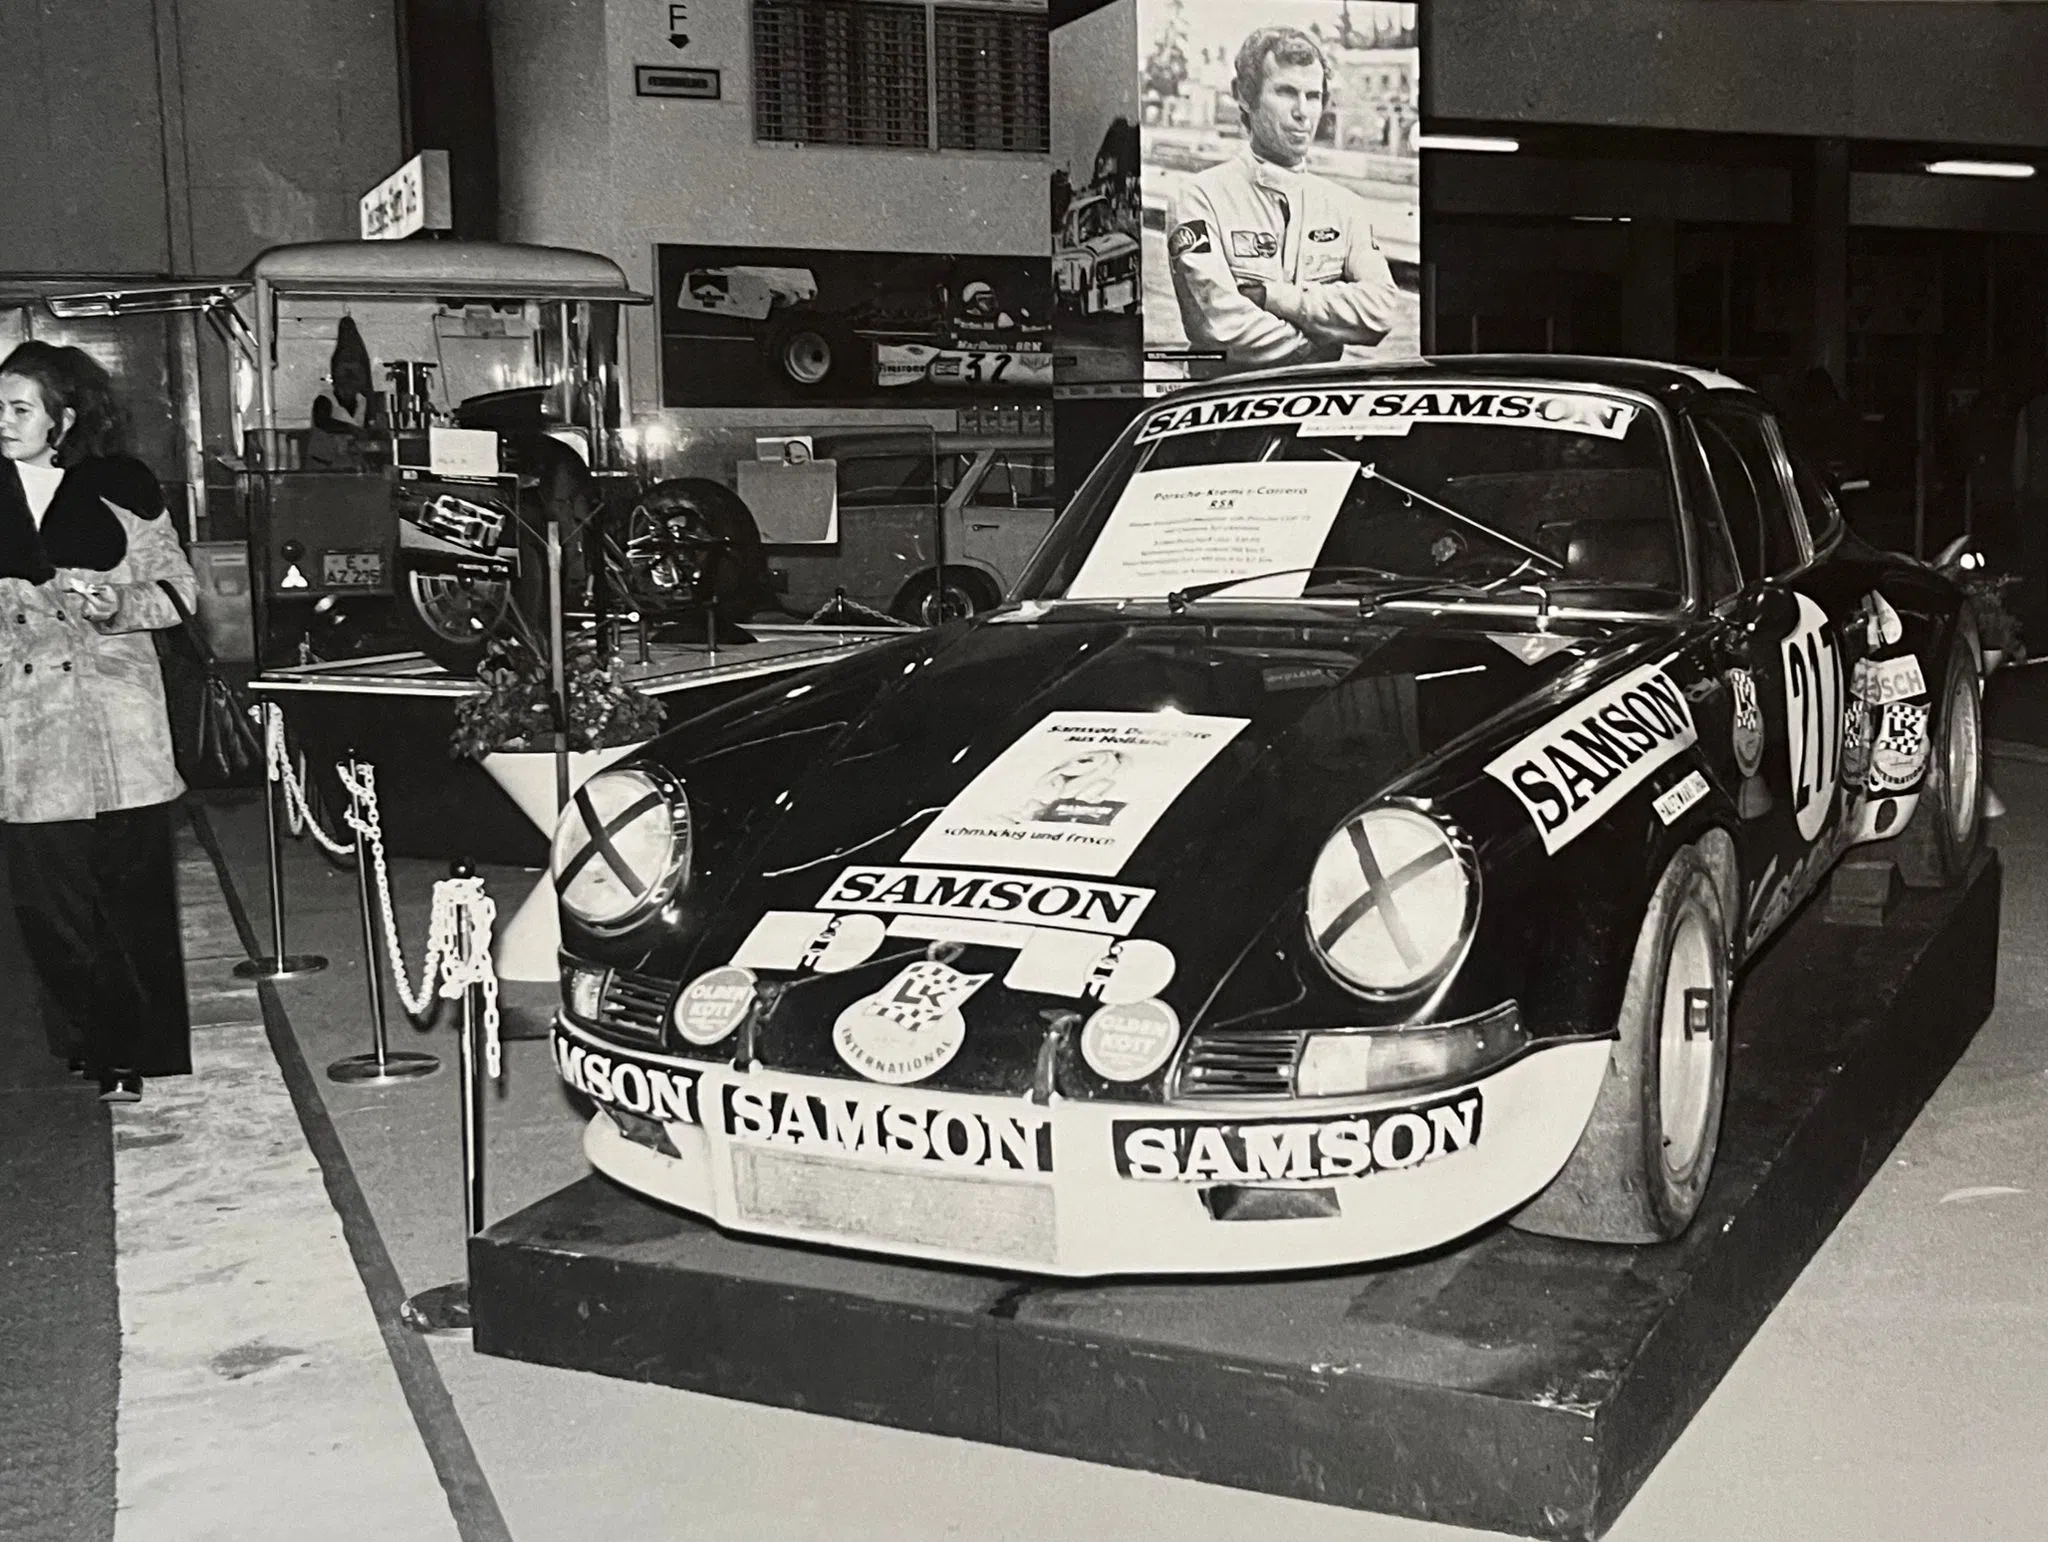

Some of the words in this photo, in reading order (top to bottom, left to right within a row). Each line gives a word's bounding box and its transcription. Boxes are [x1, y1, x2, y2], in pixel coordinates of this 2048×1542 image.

[669, 4, 688, 31] F
[964, 353, 1012, 383] 32
[1142, 394, 1365, 437] SAMSON
[1368, 393, 1625, 430] SAMSON
[1889, 717, 1918, 738] LK
[1511, 673, 1691, 835] SAMSON
[831, 870, 1140, 924] SAMSON
[892, 978, 947, 1008] LK
[842, 1027, 952, 1074] INTERNATIONAL
[731, 1086, 1053, 1169] SAMSON
[1124, 1098, 1479, 1182] SAMSON
